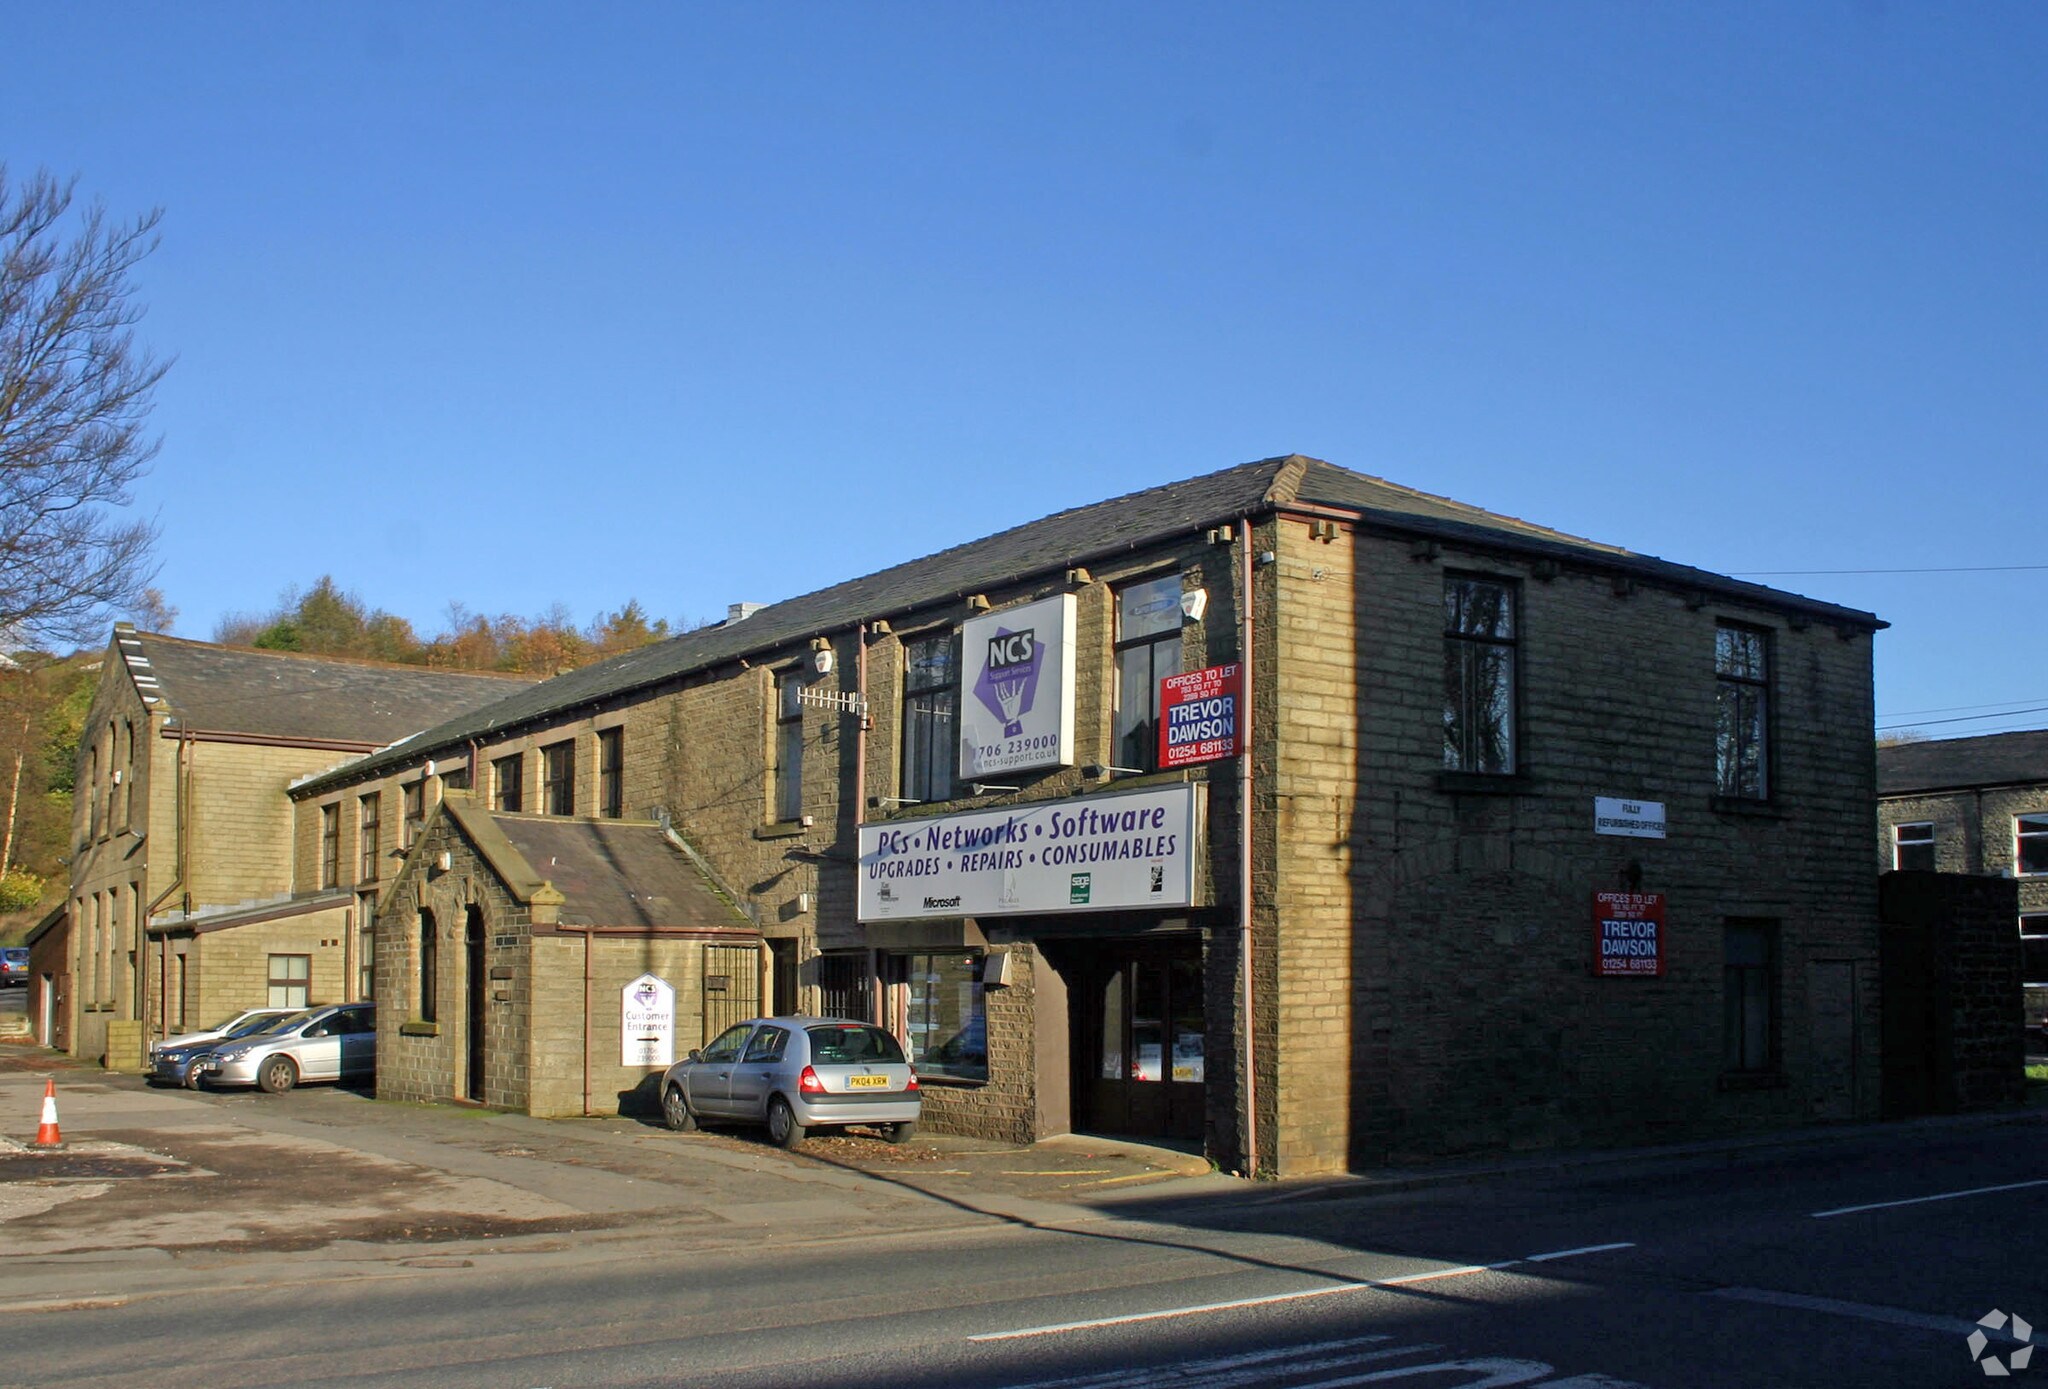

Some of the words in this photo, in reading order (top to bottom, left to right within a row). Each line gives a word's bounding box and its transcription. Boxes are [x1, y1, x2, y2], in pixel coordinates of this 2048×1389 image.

[990, 633, 1032, 667] NCS
[1166, 672, 1202, 689] OFFICES
[1205, 669, 1217, 680] TO
[1220, 665, 1236, 678] LET
[1169, 697, 1234, 723] TREVOR
[1169, 717, 1234, 744] DAWSON
[1008, 734, 1057, 753] 239000
[1168, 744, 1197, 759] 01254
[1200, 738, 1233, 754] 681133
[878, 830, 910, 855] PCs
[926, 816, 1028, 850] Networks
[1050, 807, 1166, 840] Software
[869, 857, 940, 880] UPGRADES
[961, 850, 1023, 873] REPAIRS
[1042, 834, 1177, 866] CONSUMABLES
[1071, 876, 1090, 888] sage
[923, 896, 961, 909] Microsoft
[1598, 893, 1630, 903] OFFICES
[1632, 894, 1642, 903] TO
[1644, 895, 1658, 905] LET
[1602, 920, 1656, 937] TREVOR
[1602, 939, 1656, 956] DAWSON
[1602, 959, 1627, 969] 01254
[639, 984, 656, 993] NCS
[626, 1011, 669, 1020] Customer
[627, 1022, 668, 1031] Entrance
[851, 1077, 870, 1086] PK04
